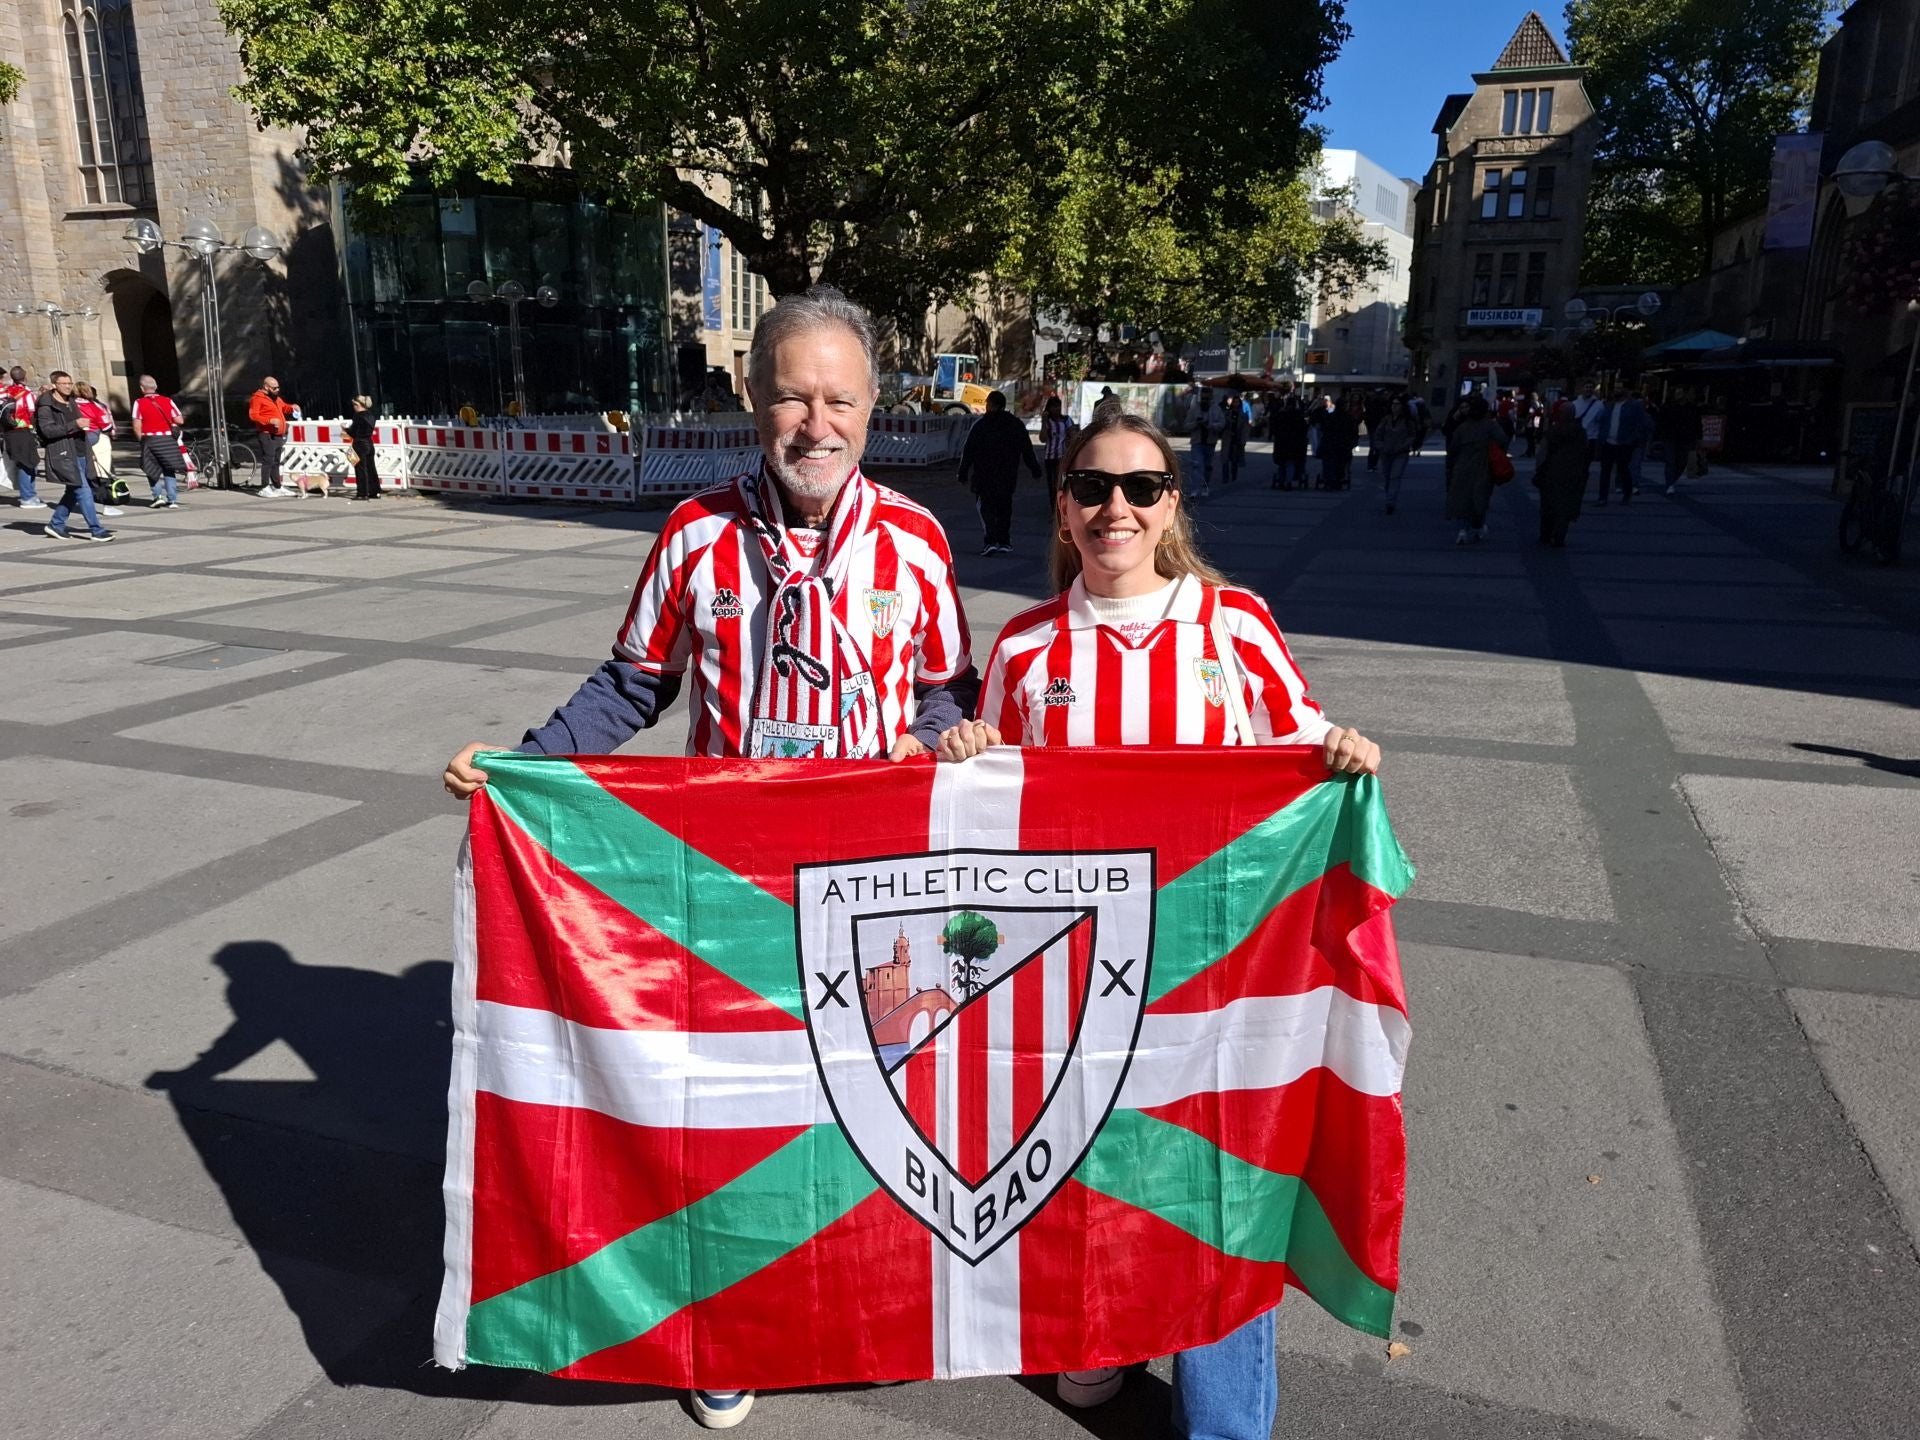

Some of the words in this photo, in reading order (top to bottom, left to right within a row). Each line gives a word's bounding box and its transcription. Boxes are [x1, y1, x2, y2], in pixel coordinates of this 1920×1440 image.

[1470, 310, 1523, 320] MUSIKBOX
[711, 607, 744, 617] Kappa
[1119, 622, 1152, 634] Athletic
[1044, 694, 1076, 705] Kappa
[754, 720, 797, 736] ATHLETIC
[803, 726, 835, 740] CLUB
[821, 867, 1008, 905] ATHLETIC
[1024, 867, 1130, 894] CLUB
[1099, 958, 1137, 997] X
[814, 970, 850, 1010] X
[905, 1138, 1053, 1245] BILBAO
